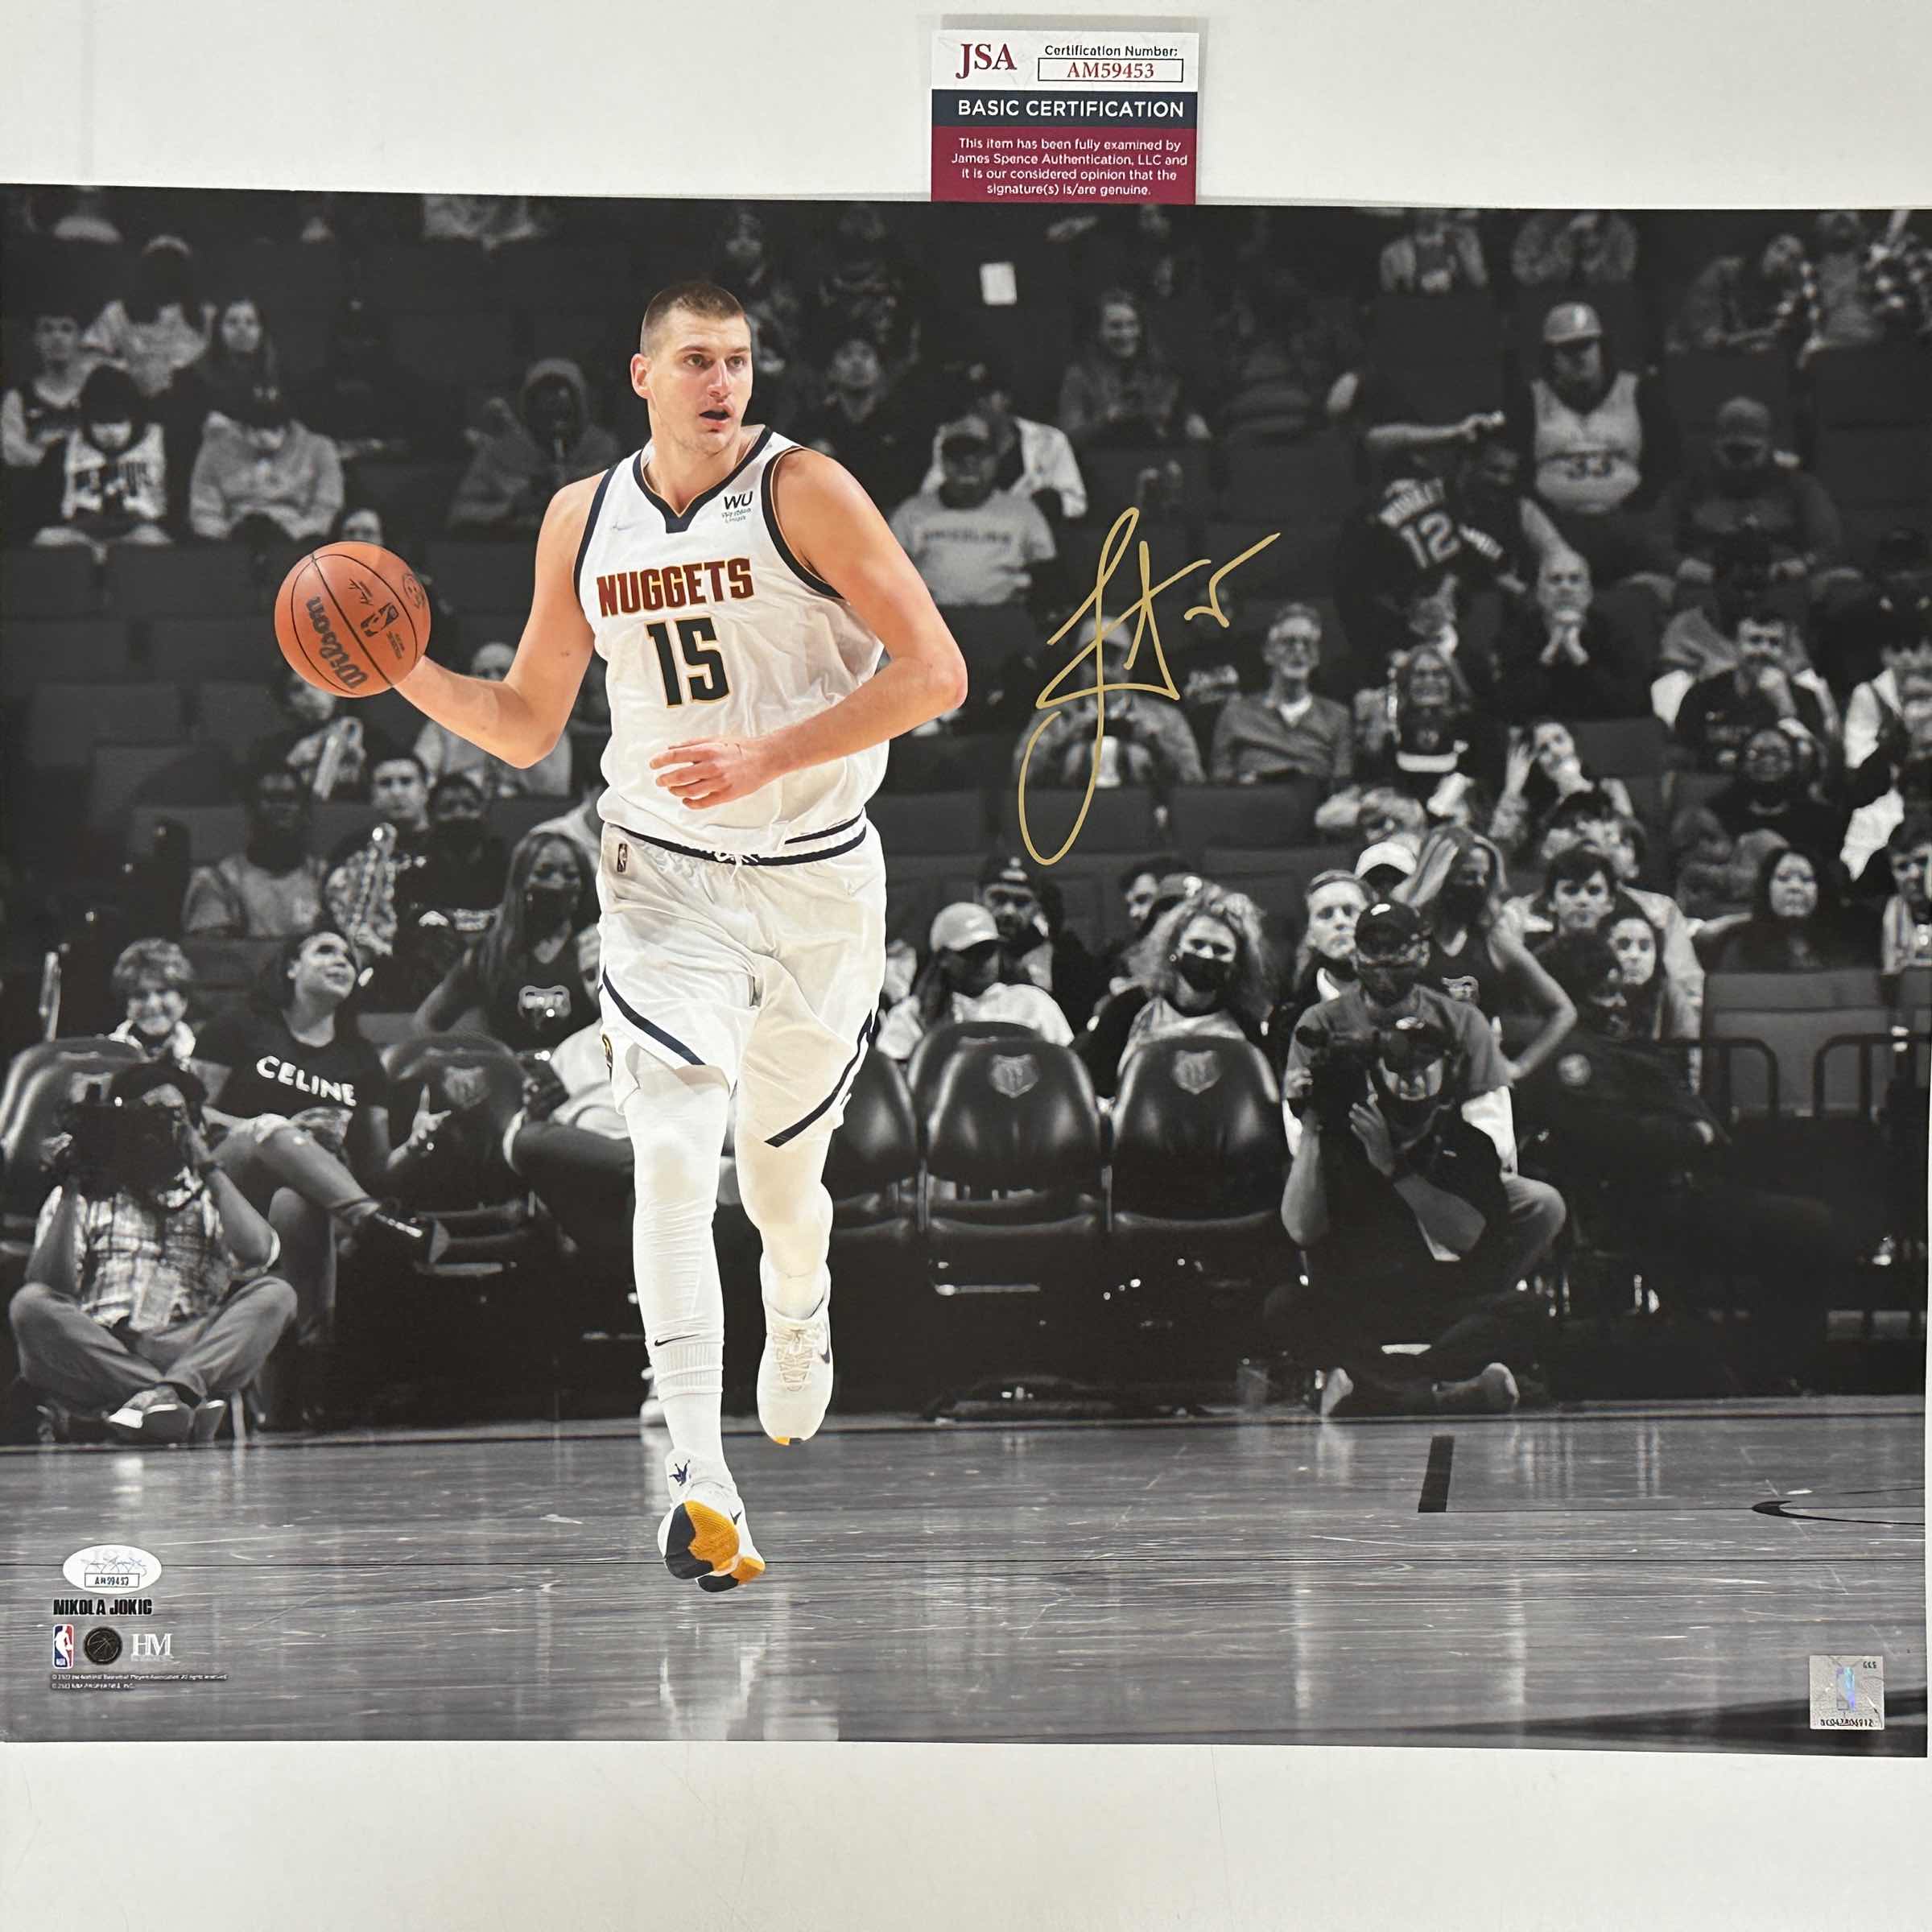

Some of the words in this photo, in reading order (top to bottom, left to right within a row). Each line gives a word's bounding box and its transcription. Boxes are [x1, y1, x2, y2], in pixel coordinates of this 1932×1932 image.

[1045, 45, 1121, 56] Certification
[1125, 46, 1178, 56] Number:
[956, 43, 1018, 79] JSA
[1067, 62, 1154, 78] AM59453
[958, 100, 1019, 116] BASIC
[1026, 101, 1183, 117] CERTIFICATION
[960, 138, 983, 148] This
[987, 138, 1013, 148] item
[1018, 138, 1038, 149] has
[1041, 138, 1071, 149] been
[1075, 138, 1100, 151] fully
[1104, 139, 1162, 151] examined
[1166, 139, 1181, 152] by
[952, 153, 989, 164] James
[993, 153, 1038, 165] Spence
[1042, 154, 1133, 166] Authentication,
[1137, 155, 1162, 165] LLC
[1165, 155, 1187, 166] and
[962, 168, 969, 179] it
[974, 168, 983, 179] is
[986, 171, 1006, 179] our
[1010, 168, 1076, 179] considered
[1080, 169, 1125, 181] opinion
[1129, 169, 1153, 180] that
[1158, 169, 1177, 180] the
[987, 184, 1059, 196] signature(s)
[1063, 184, 1096, 196] is/are
[1100, 184, 1151, 196] genuine.
[724, 491, 753, 510] WU
[1400, 513, 1461, 568] 12
[597, 558, 754, 617] NUGGETS
[307, 597, 367, 688] Wilson
[646, 617, 732, 708] 15
[256, 1055, 357, 1106] CELINE
[53, 1599, 105, 1615] NIKOLA
[109, 1599, 152, 1615] JOKIC
